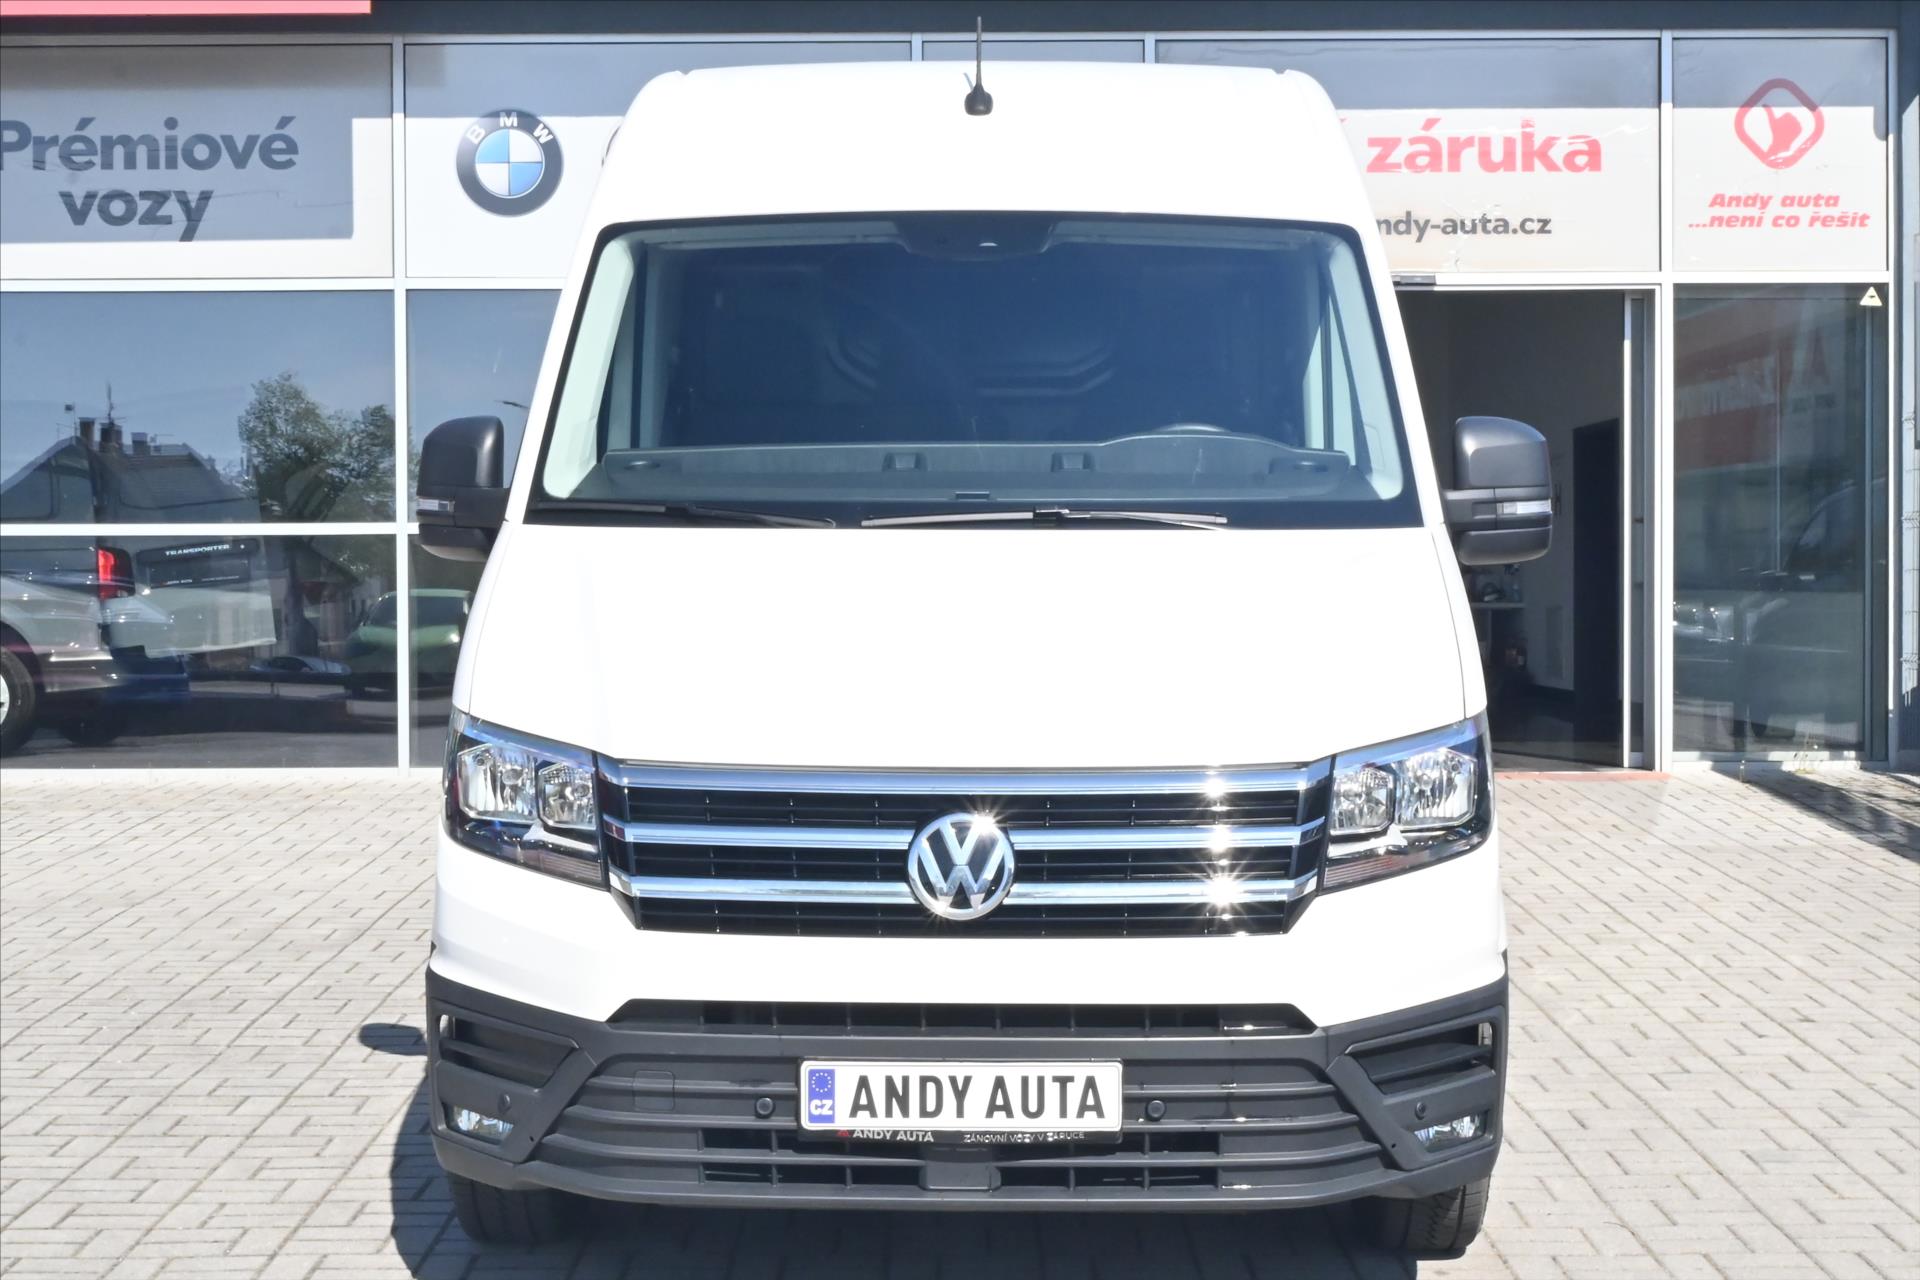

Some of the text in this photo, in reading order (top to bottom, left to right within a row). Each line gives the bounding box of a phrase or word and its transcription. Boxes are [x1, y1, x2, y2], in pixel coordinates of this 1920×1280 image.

[0, 116, 298, 171] Prémiové
[465, 111, 554, 145] BMW
[1366, 117, 1602, 174] záruka
[59, 190, 214, 242] vozy
[1708, 193, 1841, 210] Andy auta
[1376, 210, 1553, 243] ndy-auta.cz
[1771, 214, 1801, 228] co
[809, 1099, 834, 1116] CZ
[848, 1075, 1106, 1119] ANDY AUTA
[852, 1128, 934, 1143] ANDY AUTA
